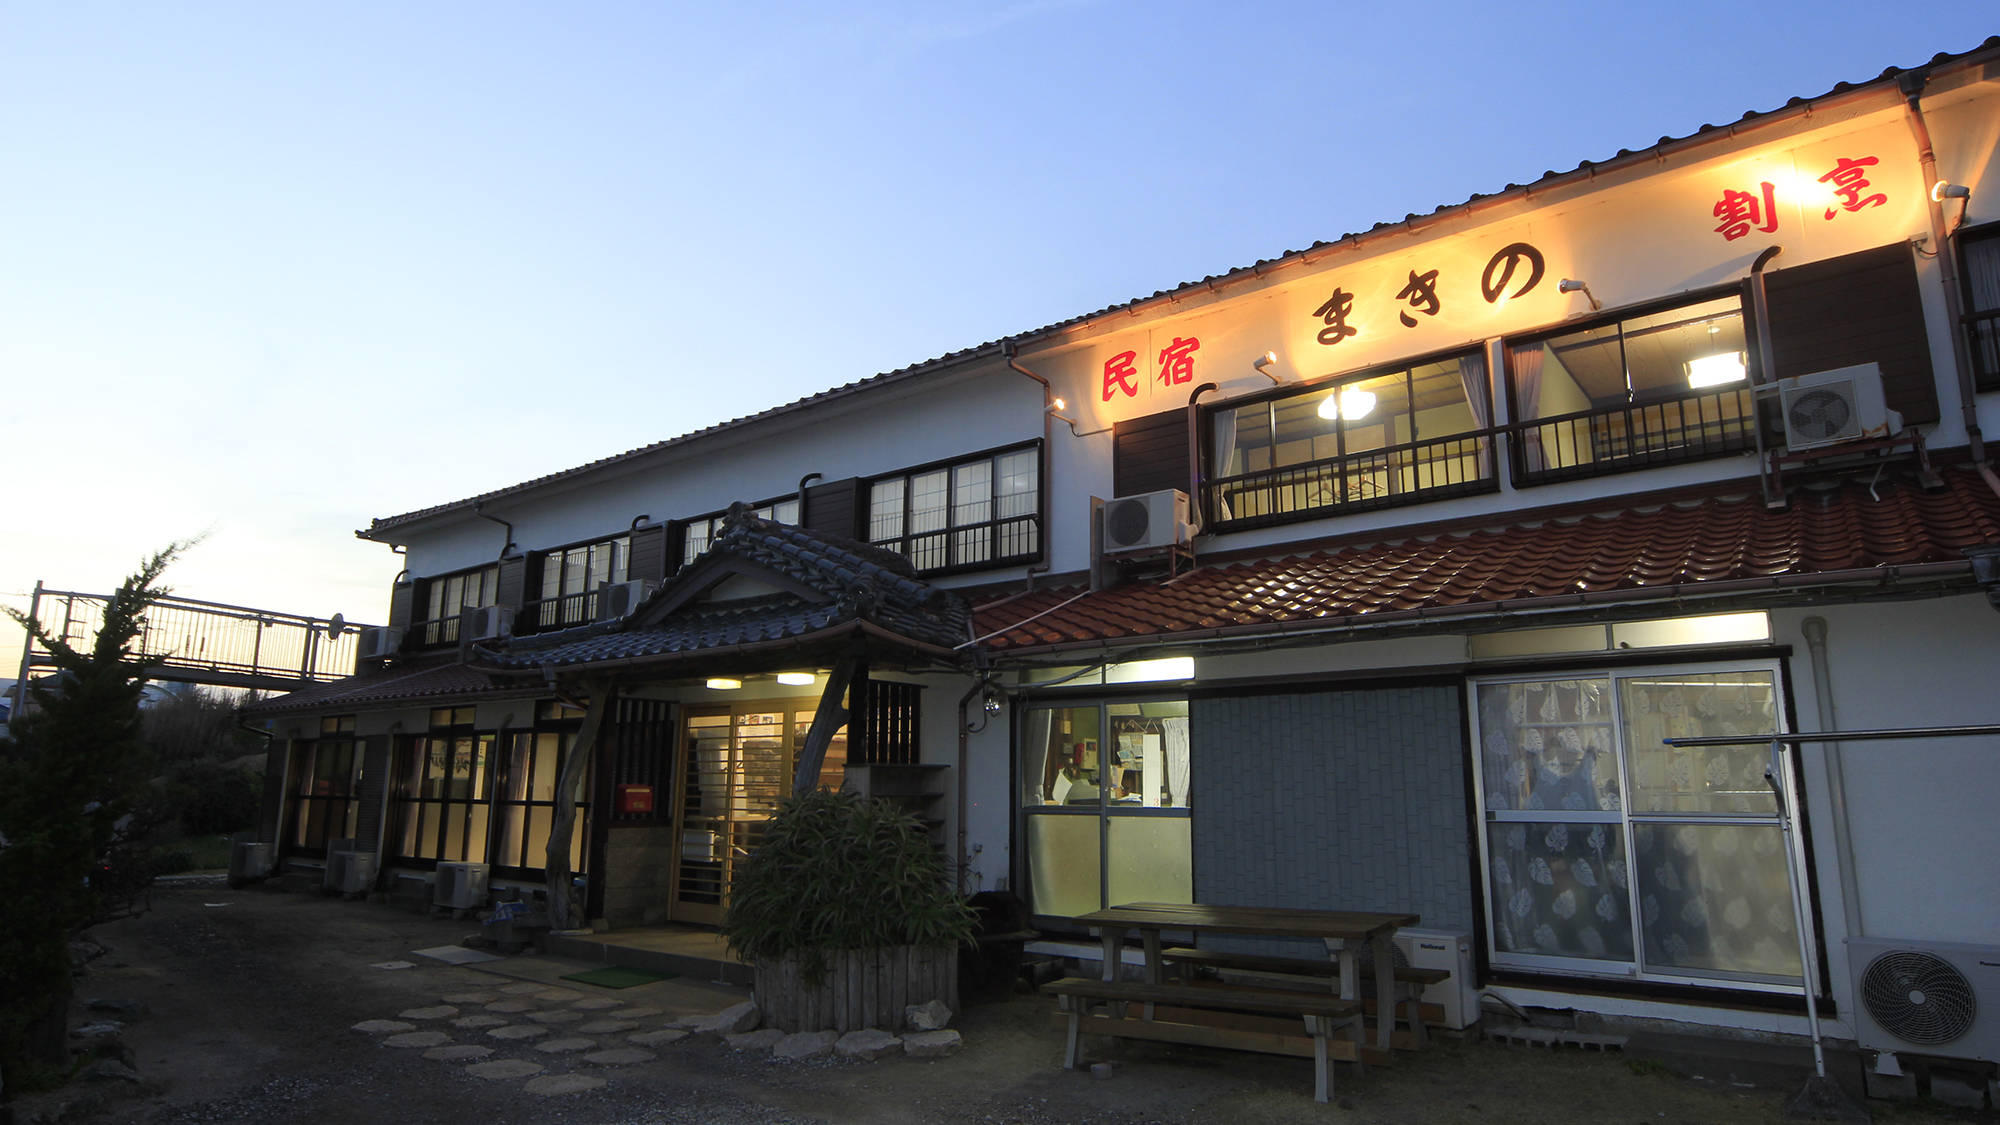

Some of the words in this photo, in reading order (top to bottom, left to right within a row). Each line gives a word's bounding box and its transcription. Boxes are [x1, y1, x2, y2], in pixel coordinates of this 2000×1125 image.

[1102, 337, 1200, 402] 民宿
[1312, 242, 1545, 345] まきの
[1713, 156, 1888, 242] 割烹
[1153, 798, 1160, 807] 3
[1420, 943, 1445, 951] National
